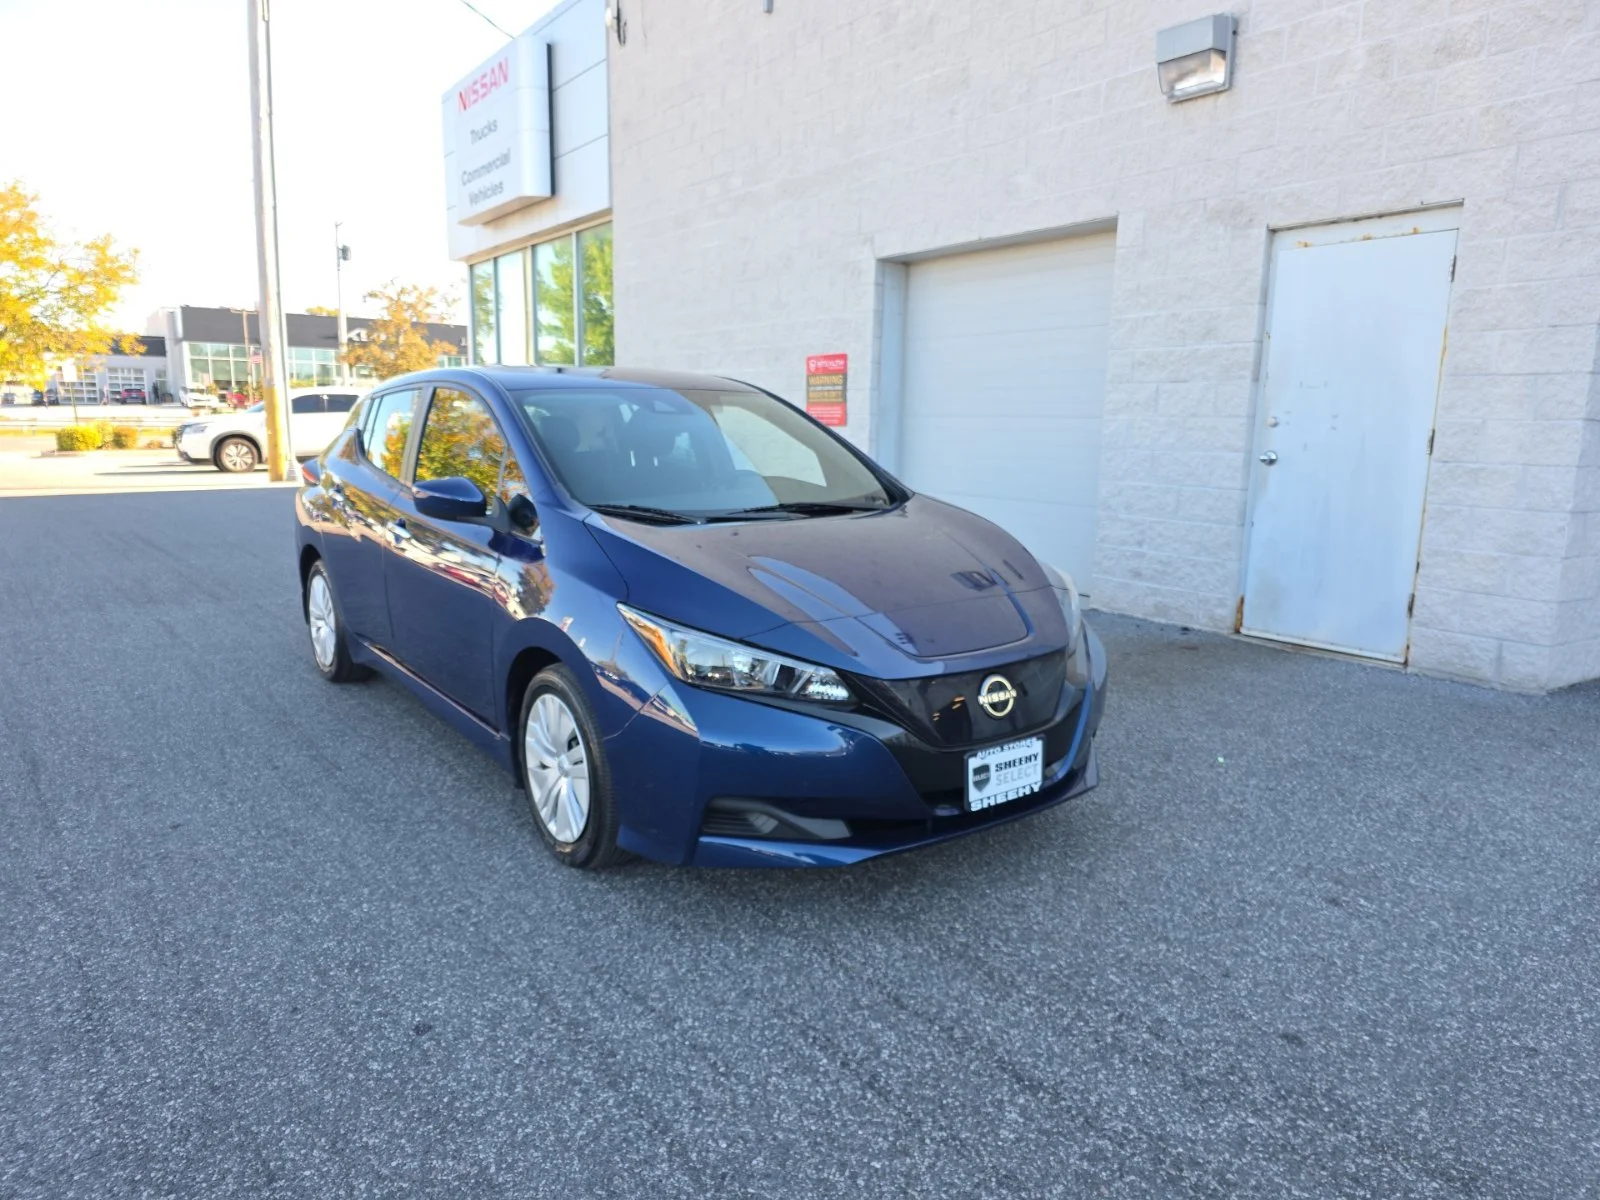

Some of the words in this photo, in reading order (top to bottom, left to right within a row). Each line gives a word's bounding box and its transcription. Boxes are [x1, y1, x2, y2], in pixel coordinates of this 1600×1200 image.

[457, 57, 508, 112] NISSAN
[470, 119, 498, 144] Trucks
[461, 147, 511, 186] Commercial
[468, 180, 504, 207] Vehicles
[809, 375, 843, 385] WARNING
[977, 689, 1017, 704] NISSAN
[995, 752, 1039, 771] SHEEHY
[995, 764, 1039, 786] SELECT
[970, 781, 1042, 812] SHEEHY
